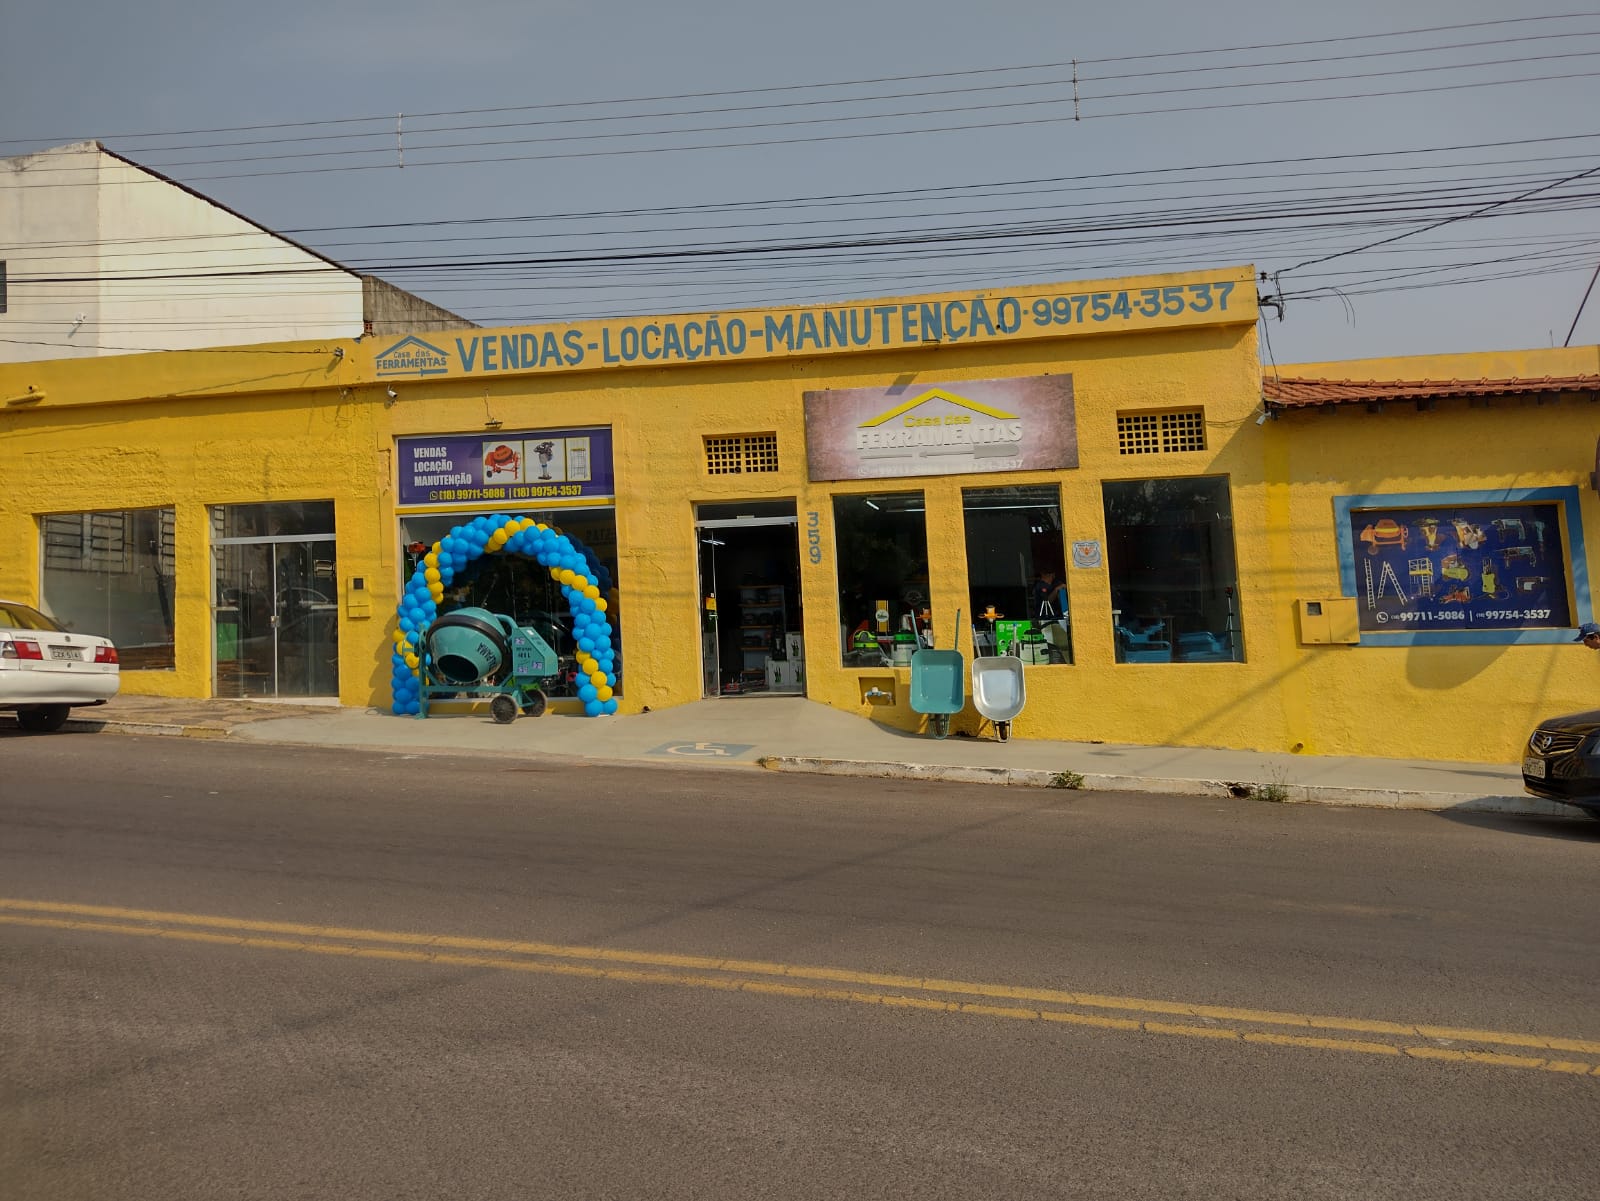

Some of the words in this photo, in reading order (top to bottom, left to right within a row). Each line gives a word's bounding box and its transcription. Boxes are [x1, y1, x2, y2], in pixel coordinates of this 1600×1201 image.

[415, 349, 431, 358] das
[376, 357, 447, 370] FERRAMENTAS
[903, 414, 942, 428] Casa
[943, 412, 973, 426] das
[856, 422, 1024, 450] FERRAMENTAS
[414, 447, 447, 459] VENDAS
[414, 459, 453, 474] LOCAÇÃO
[414, 473, 472, 487] MANUTENÇÃO
